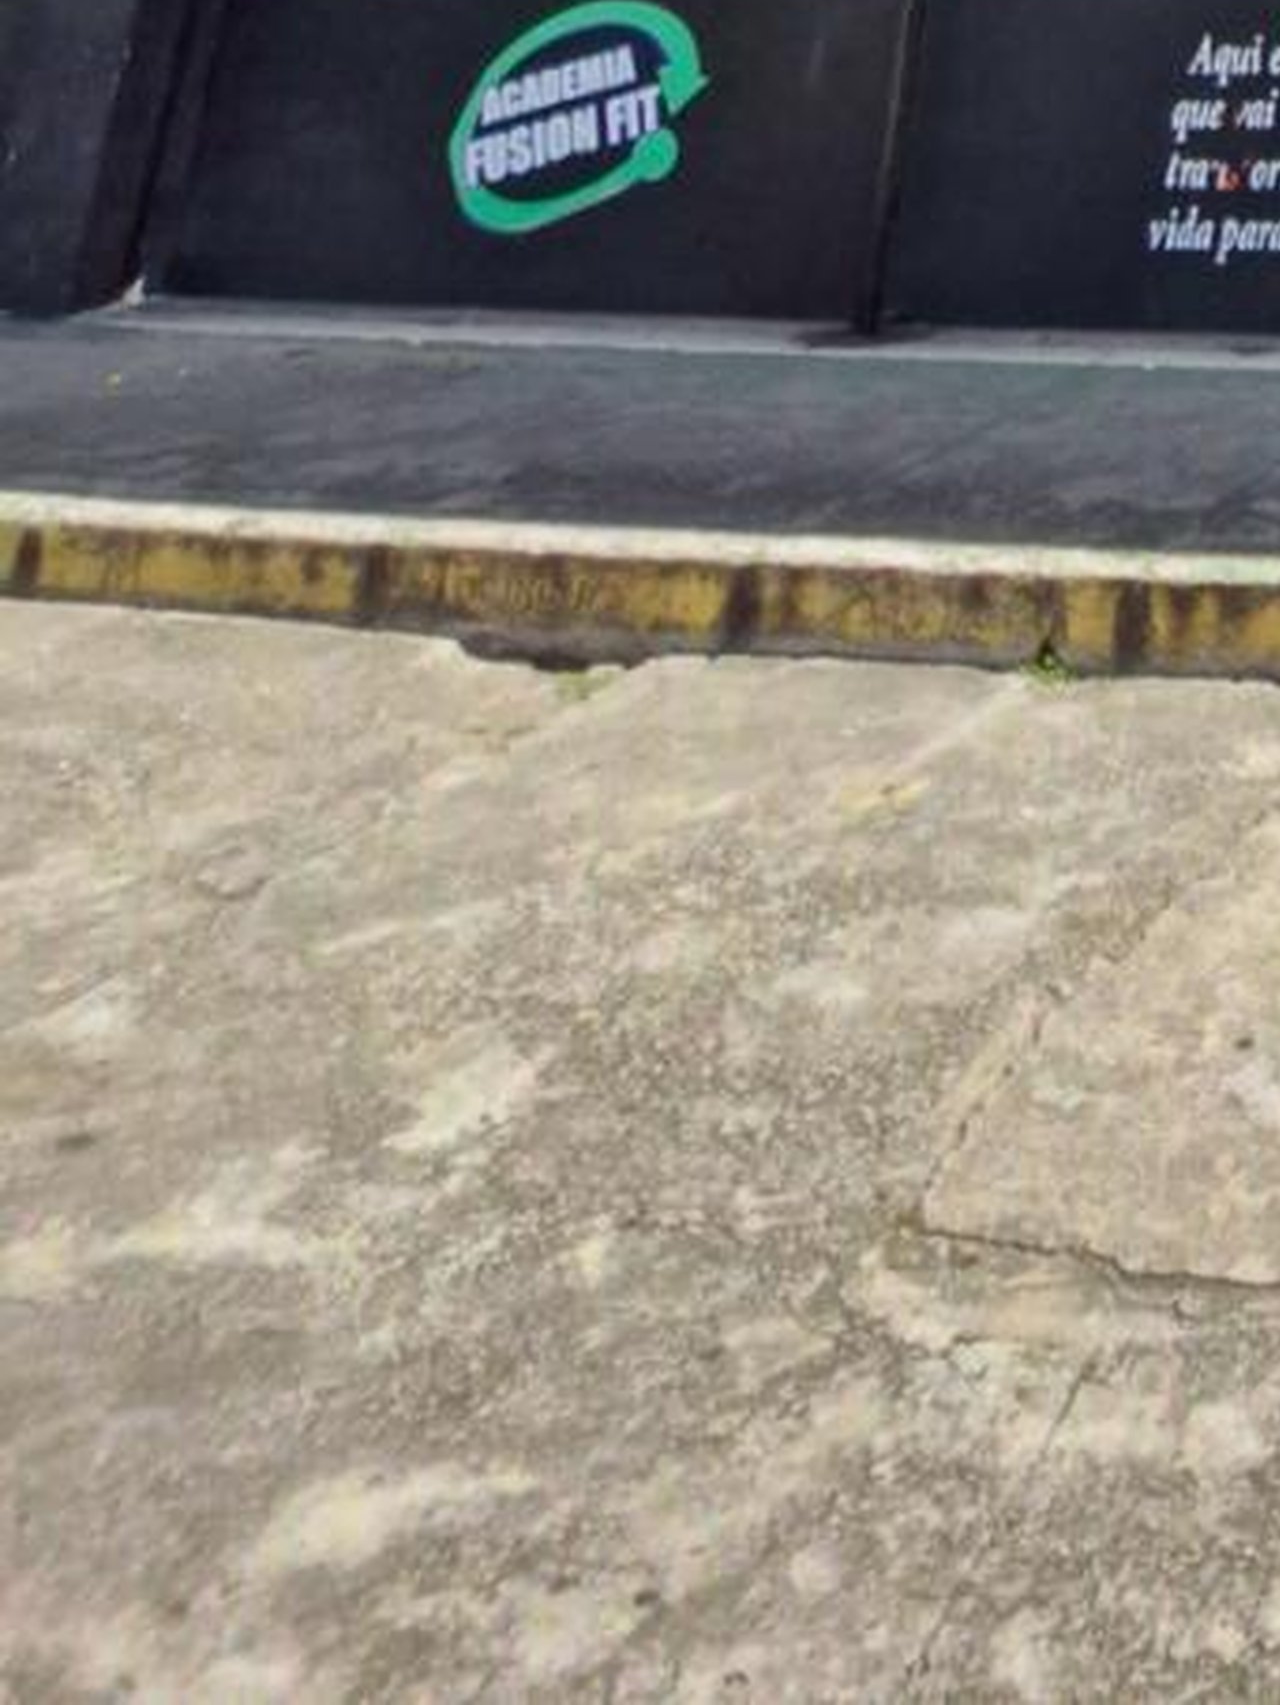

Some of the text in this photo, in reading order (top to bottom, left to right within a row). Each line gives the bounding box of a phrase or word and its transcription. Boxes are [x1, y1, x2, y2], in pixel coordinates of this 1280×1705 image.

[480, 43, 637, 128] ACADEMIA
[1186, 31, 1264, 87] Aqui
[464, 85, 661, 189] FUSION FIT
[1171, 98, 1226, 144] que
[1148, 204, 1215, 251] vida
